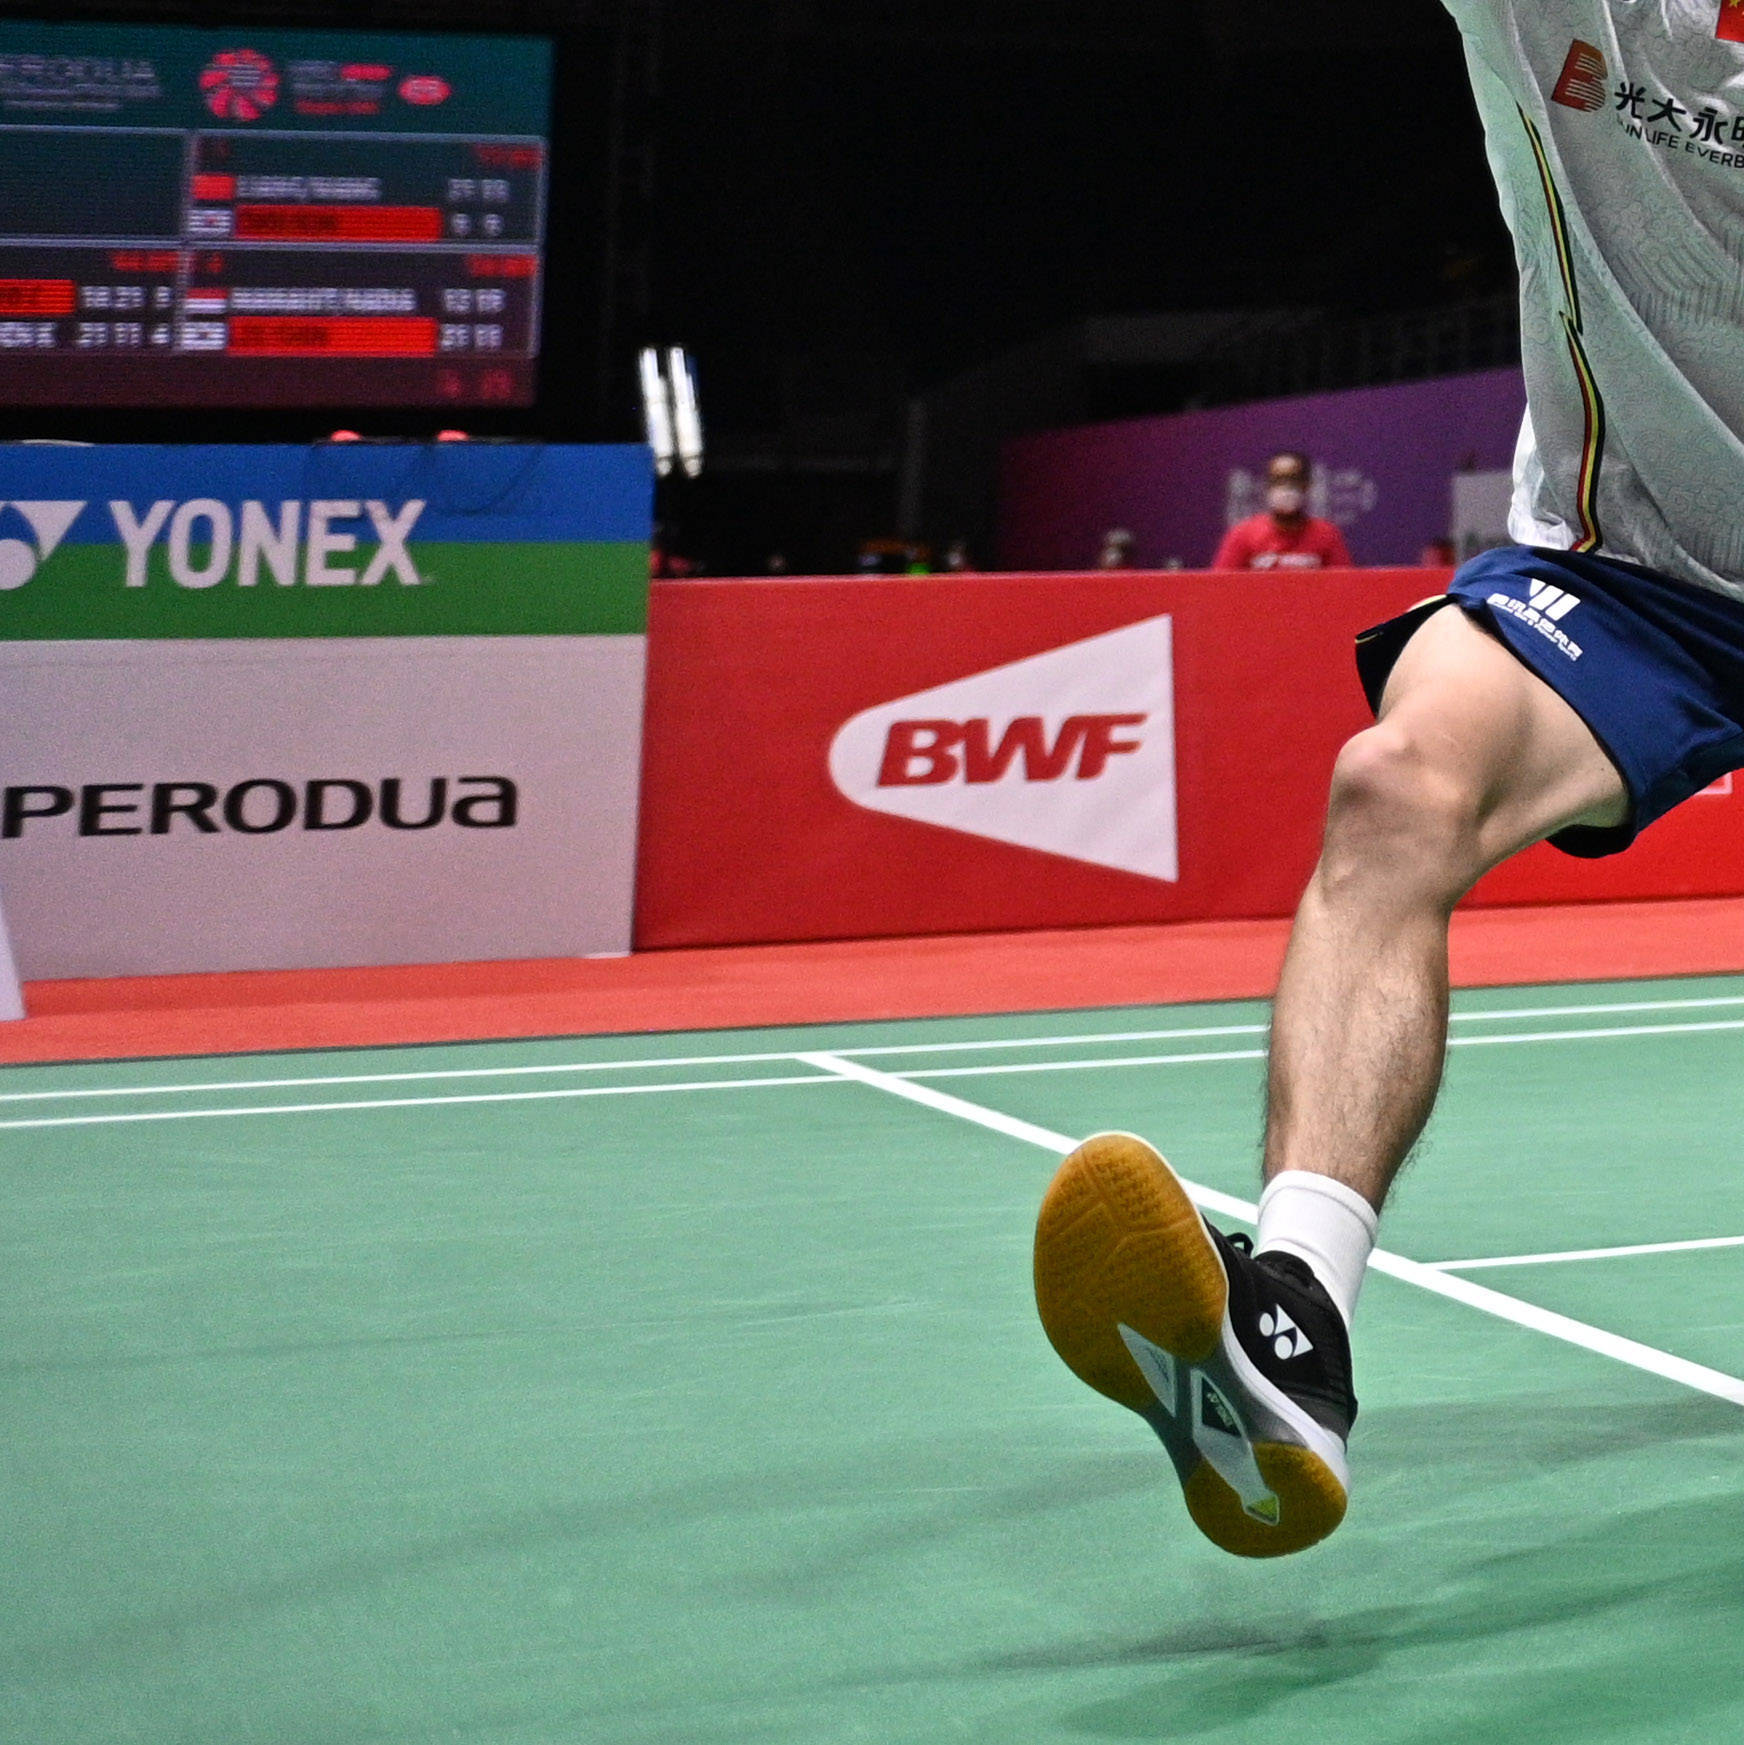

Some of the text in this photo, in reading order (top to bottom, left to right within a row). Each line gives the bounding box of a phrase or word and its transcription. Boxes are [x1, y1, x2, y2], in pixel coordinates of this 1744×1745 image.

[1645, 128, 1680, 149] LIFE
[108, 499, 427, 588] YONEX
[876, 713, 1149, 789] BWF
